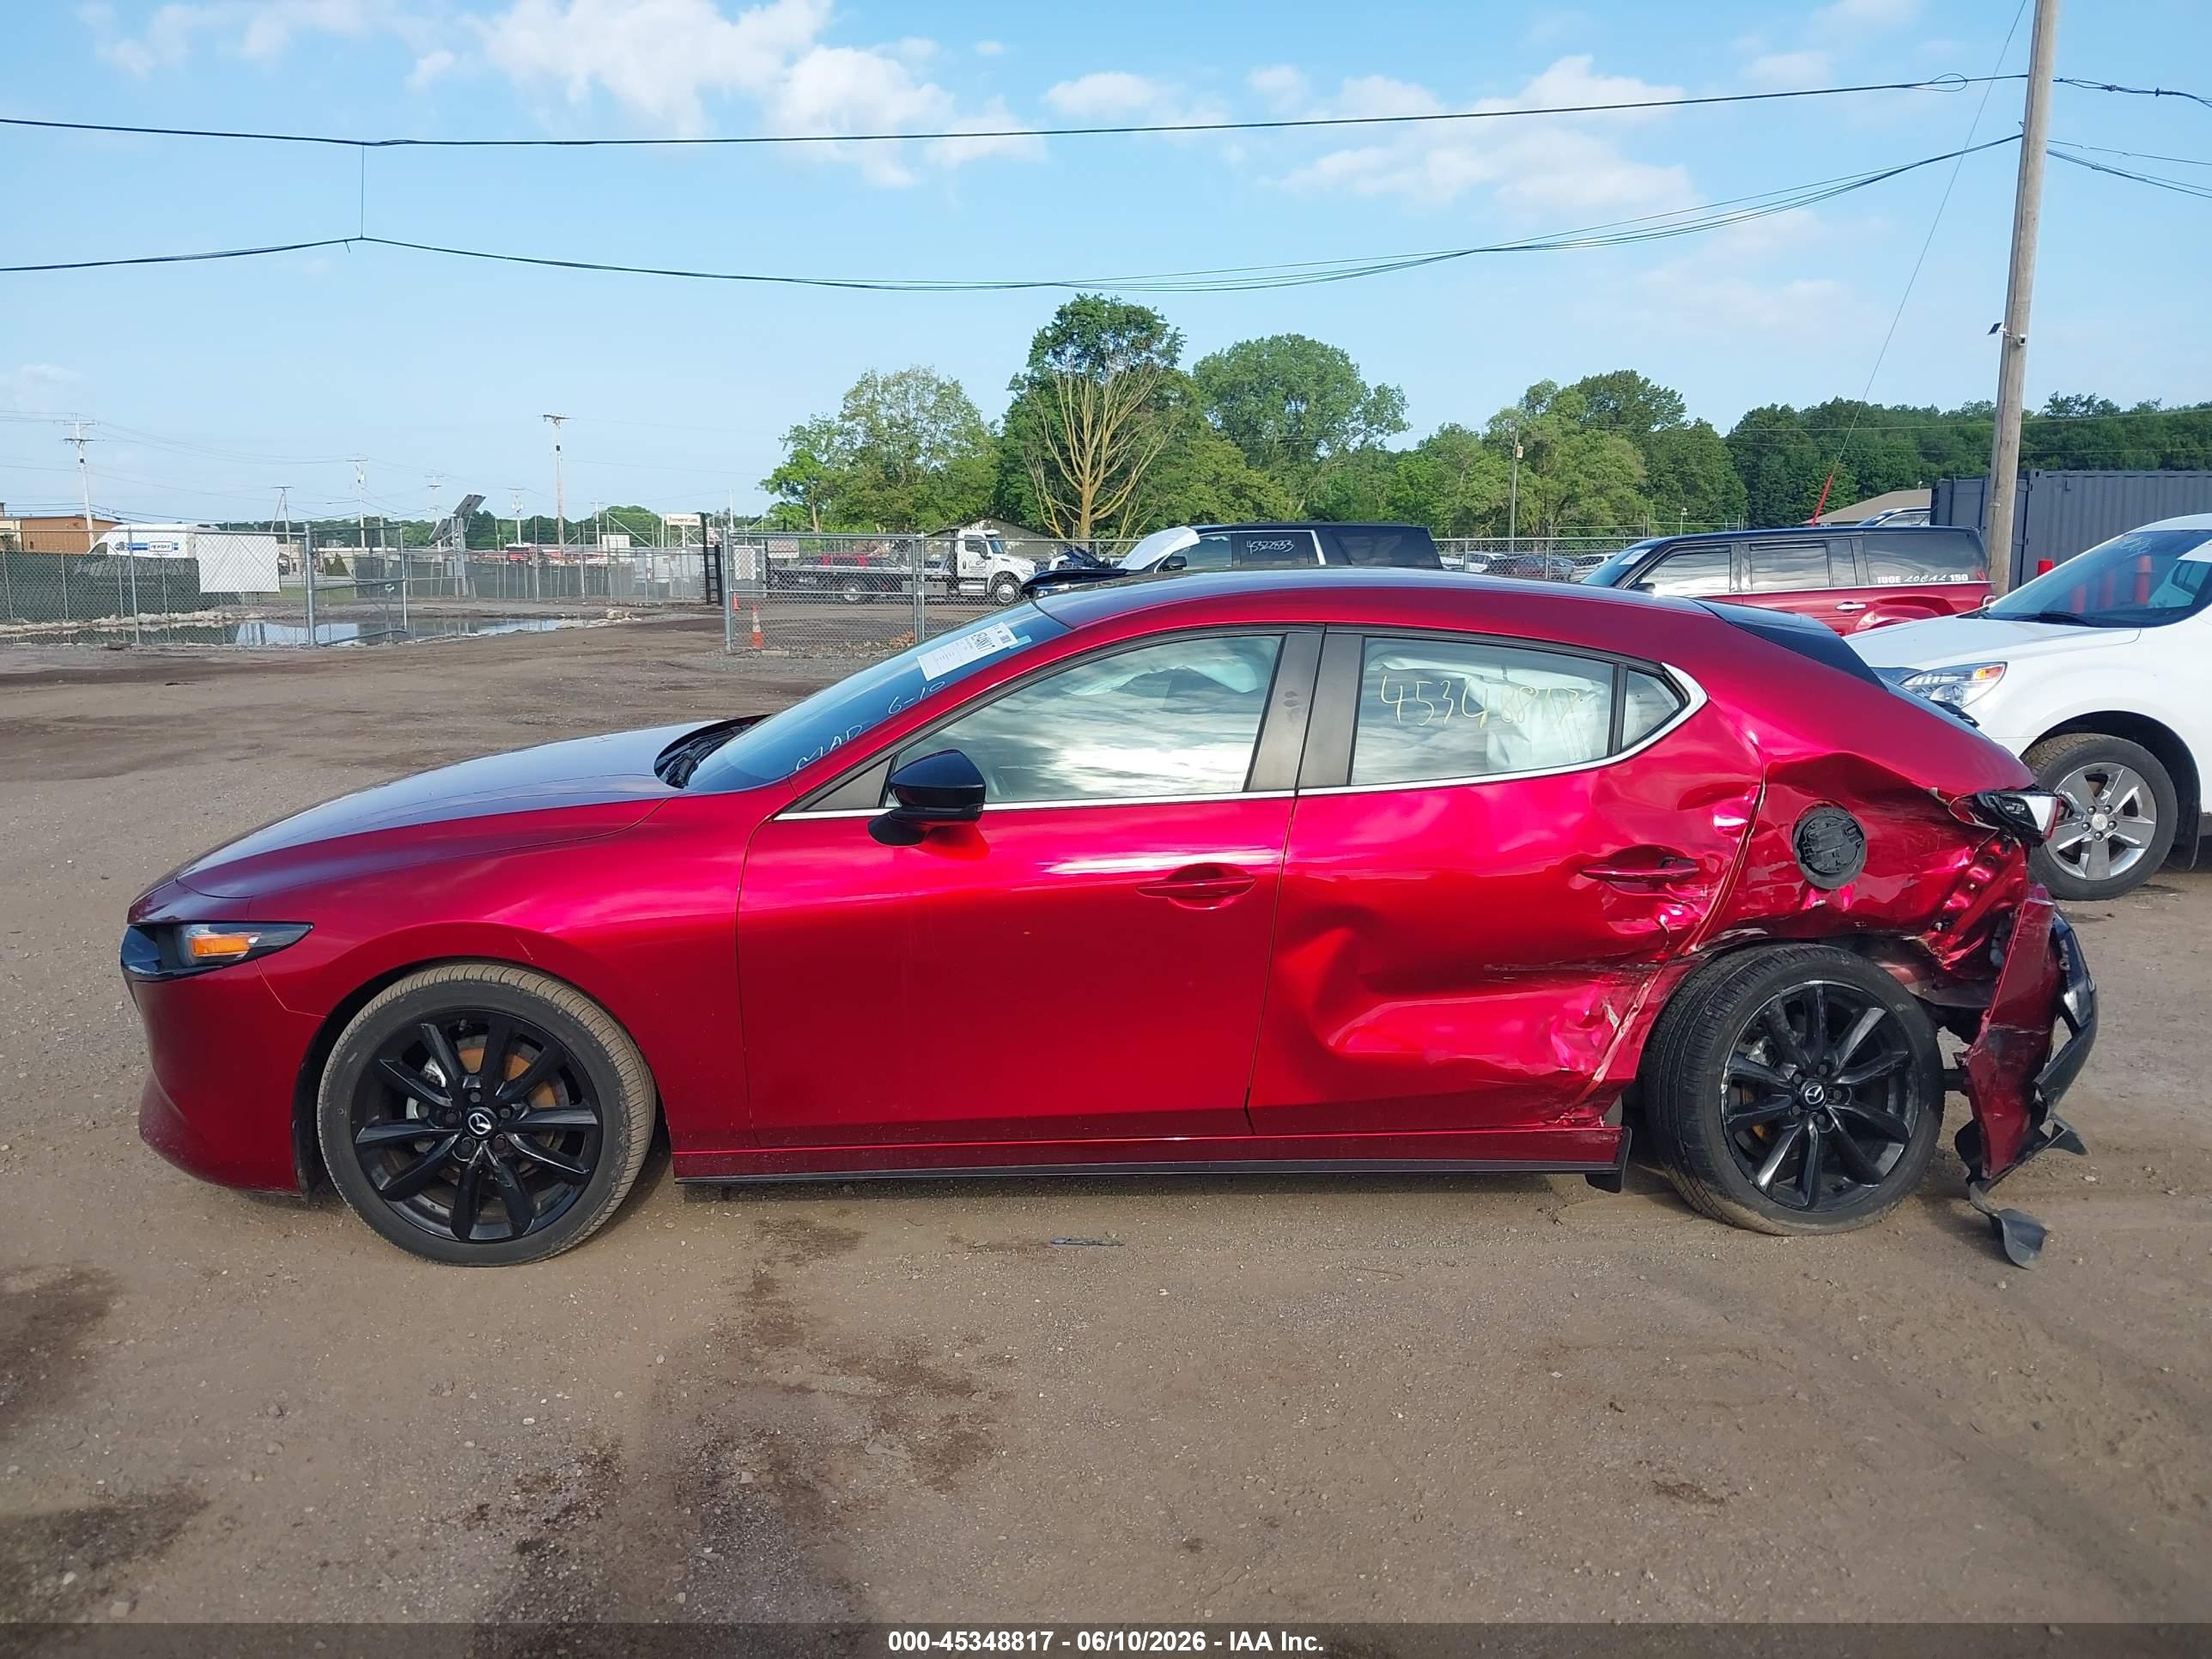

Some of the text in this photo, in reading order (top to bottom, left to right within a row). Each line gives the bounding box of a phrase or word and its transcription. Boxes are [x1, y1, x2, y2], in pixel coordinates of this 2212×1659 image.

[1904, 574, 1947, 583] LOCAL
[1949, 574, 1969, 582] 150
[888, 681, 946, 715] 6-10
